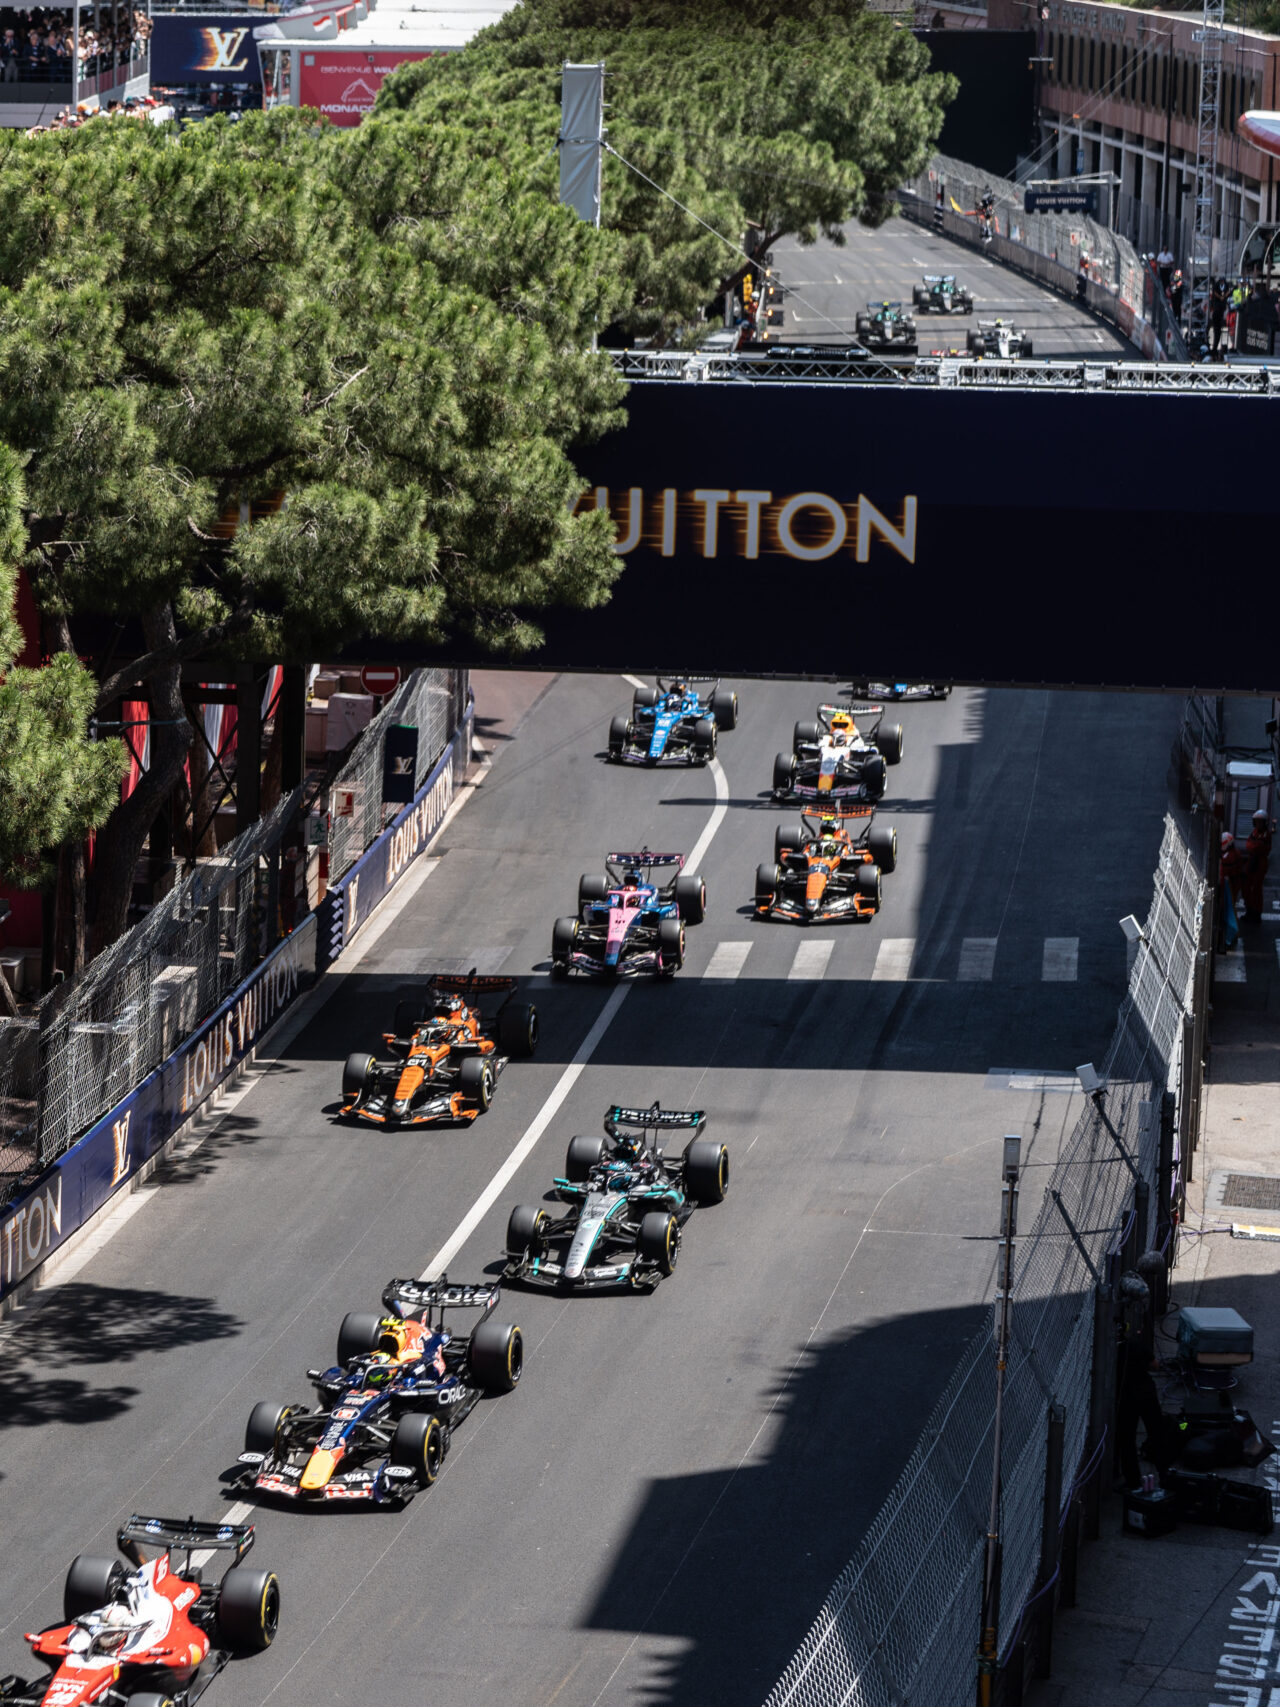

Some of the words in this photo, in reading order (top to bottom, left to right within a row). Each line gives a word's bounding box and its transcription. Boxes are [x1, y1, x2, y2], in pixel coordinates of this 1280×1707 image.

[320, 65, 372, 74] BIENVENUE
[566, 486, 919, 563] UITTON
[386, 805, 421, 886] LOUIS
[420, 758, 455, 845] VUITTON
[180, 1009, 235, 1115] LOUIS
[236, 955, 299, 1052] VUITTON
[281, 1463, 303, 1478] VISA
[343, 1472, 370, 1483] VISA
